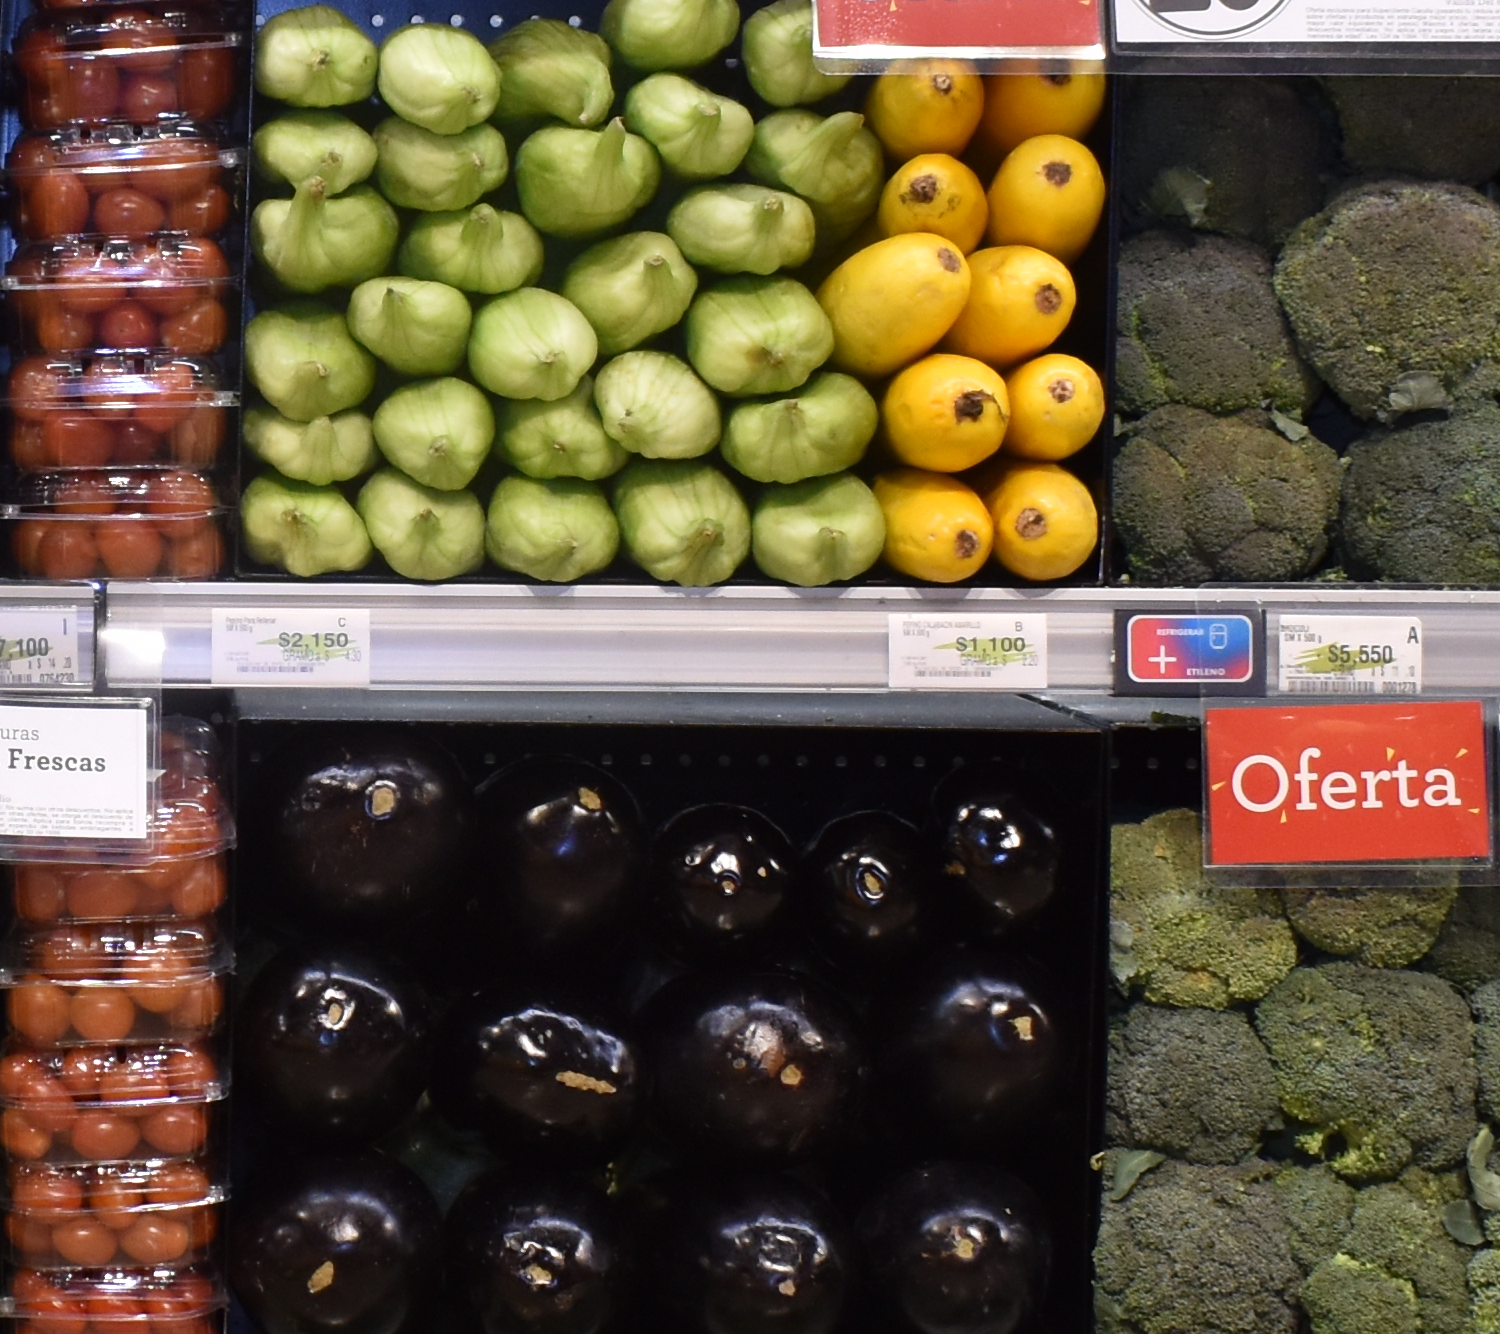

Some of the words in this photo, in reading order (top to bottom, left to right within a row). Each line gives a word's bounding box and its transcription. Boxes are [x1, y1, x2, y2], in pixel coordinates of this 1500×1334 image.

[338, 617, 346, 627] C
[1015, 622, 1023, 631] B
[278, 632, 348, 651] $2,150
[1407, 626, 1419, 643] A
[955, 637, 1026, 655] $1,100
[1328, 645, 1392, 664] $5,550
[1186, 668, 1225, 676] ETILENO
[7, 748, 106, 773] Frescas
[1231, 747, 1461, 813] Oferta
